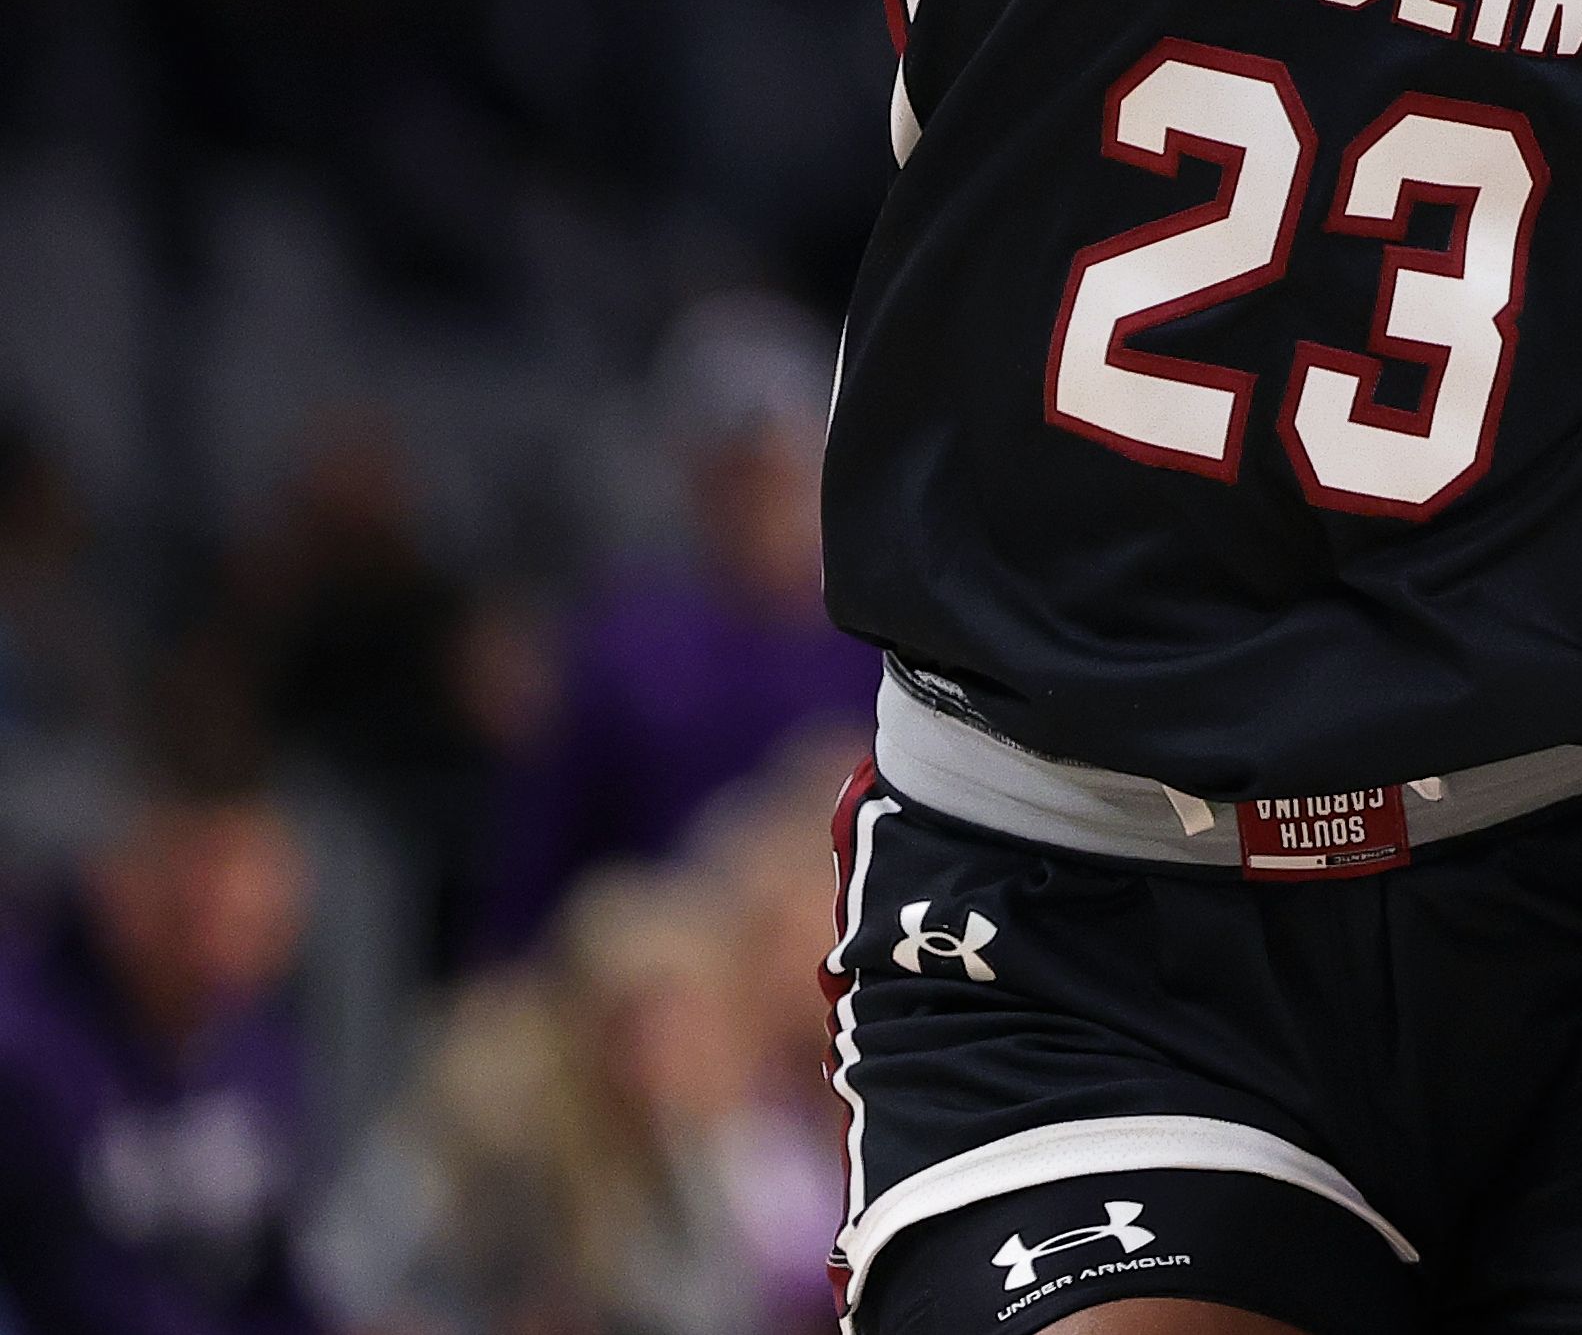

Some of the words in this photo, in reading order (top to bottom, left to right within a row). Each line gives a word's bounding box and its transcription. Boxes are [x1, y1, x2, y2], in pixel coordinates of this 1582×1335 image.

[1045, 36, 1551, 523] 23
[1280, 815, 1366, 850] SOUTH
[996, 1274, 1074, 1322] UNDER
[1079, 1254, 1192, 1281] ARMOUR
